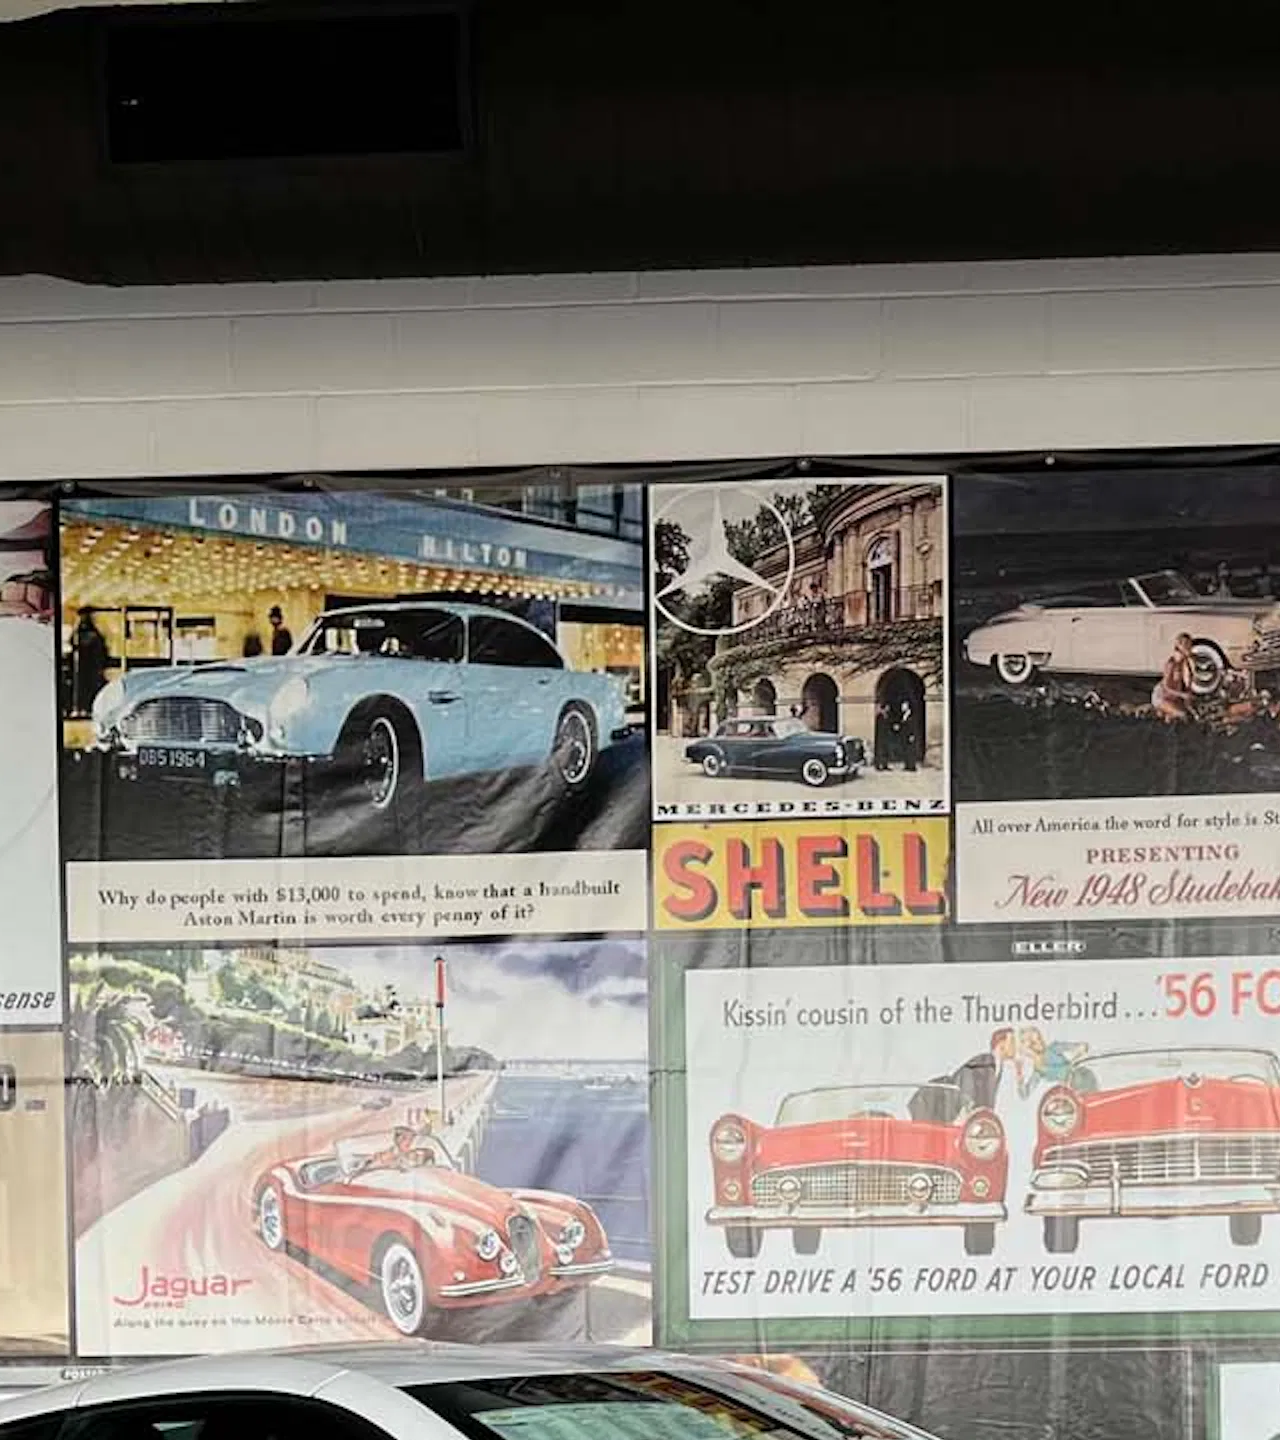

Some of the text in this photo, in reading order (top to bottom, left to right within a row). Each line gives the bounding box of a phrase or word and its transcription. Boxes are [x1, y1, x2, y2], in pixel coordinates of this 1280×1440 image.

[188, 497, 528, 569] LONDON HILTON
[656, 800, 946, 815] MERCEDES-BENZ
[971, 818, 994, 835] All
[997, 822, 1031, 833] over
[1035, 815, 1101, 833] America
[1105, 815, 1129, 830] the
[1133, 813, 1171, 830] word
[1177, 813, 1199, 828] for
[1205, 811, 1241, 830] style
[1245, 812, 1258, 826] is
[1086, 844, 1240, 864] PRESENTING
[661, 832, 947, 922] SHELL
[994, 874, 1069, 909] New
[1073, 871, 1147, 907] 1948
[98, 879, 621, 910] Why do people with $13,000 to spend, know that a handbuilt
[184, 902, 535, 928] Aston Martin is worth every penny of it?
[722, 997, 791, 1027] Kissin'
[796, 998, 868, 1026] cousin
[879, 995, 906, 1025] of
[914, 996, 954, 1024] the
[1155, 972, 1217, 1018] '56
[112, 1265, 254, 1307] Jaguar
[701, 1270, 756, 1296] TEST
[764, 1268, 835, 1295] DRIVE
[840, 1269, 858, 1294] A
[867, 1267, 904, 1292] '56
[914, 1266, 977, 1292] FORD
[985, 1266, 1018, 1291] AT
[1030, 1264, 1097, 1290] YOUR
[1109, 1263, 1185, 1290] LOCAL
[1199, 1262, 1269, 1289] FORD
